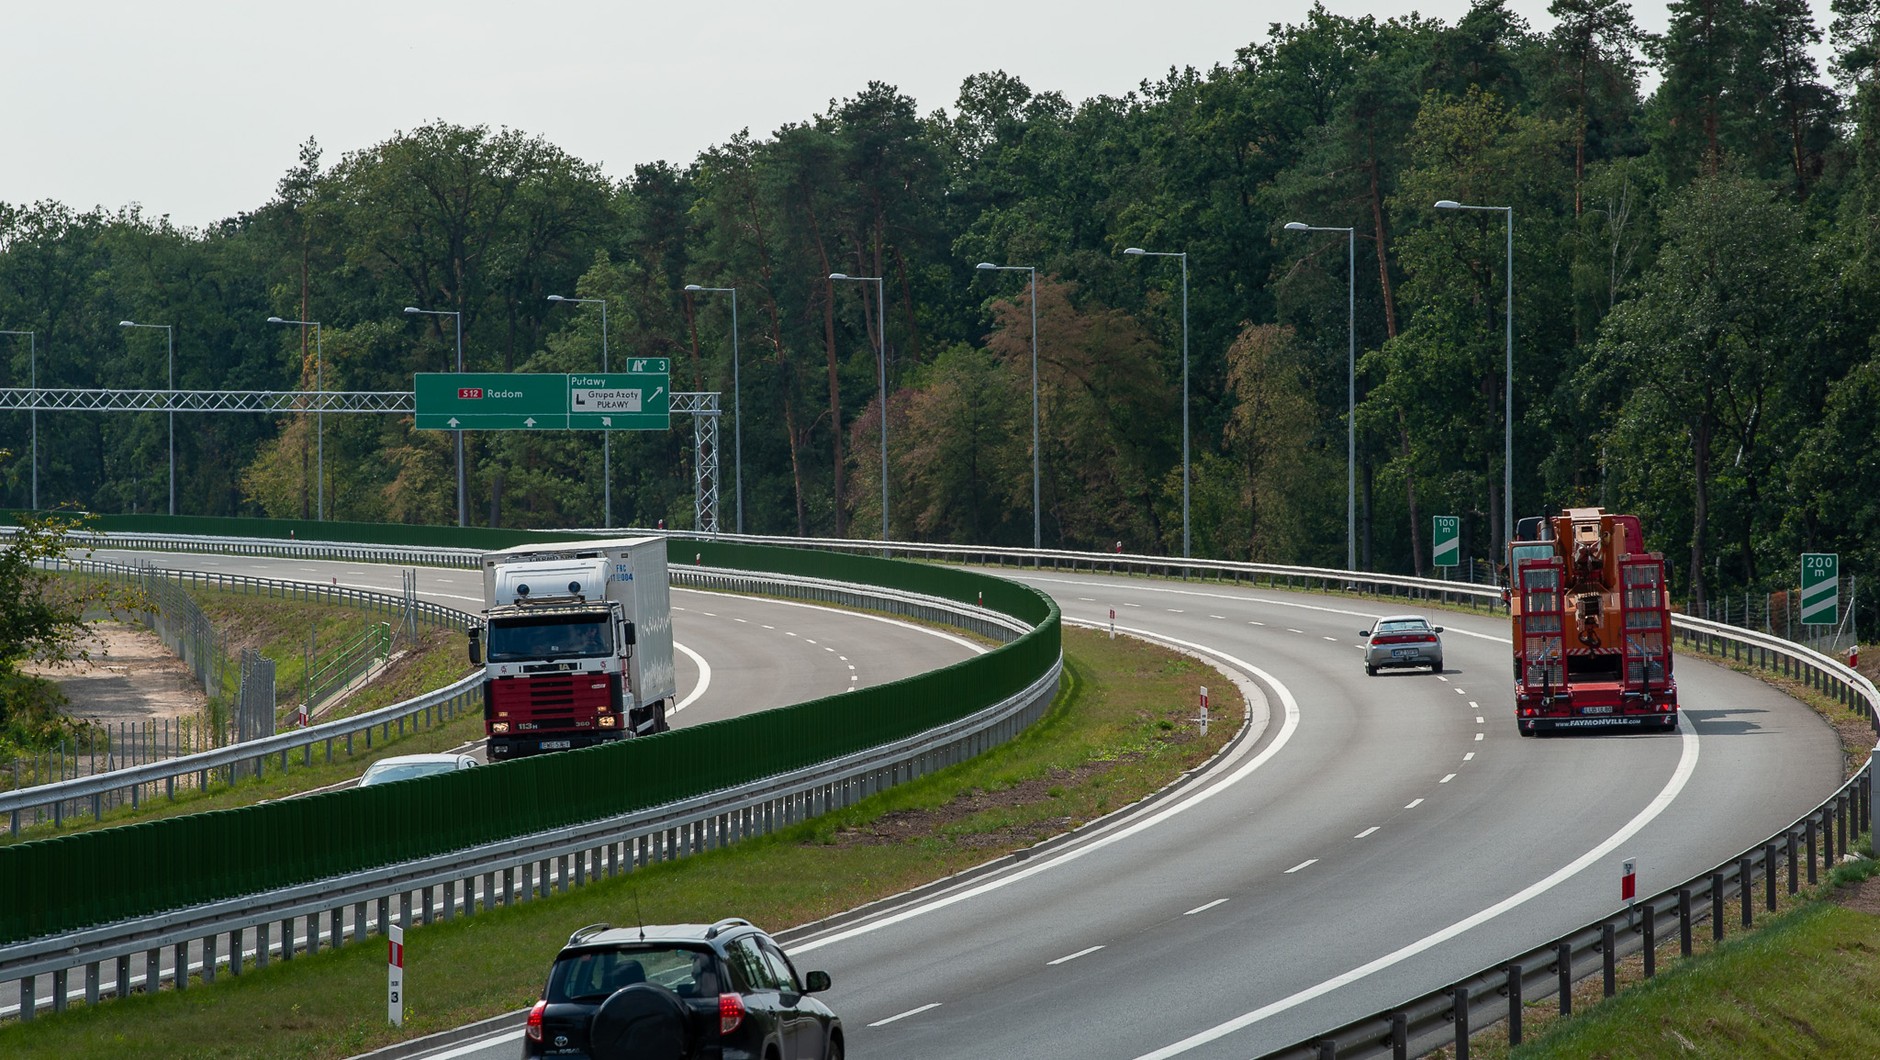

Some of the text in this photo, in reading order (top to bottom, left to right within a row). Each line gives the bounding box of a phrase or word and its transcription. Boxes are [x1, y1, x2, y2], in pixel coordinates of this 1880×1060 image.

[659, 361, 665, 371] 3
[571, 377, 606, 387] Puławy
[488, 389, 522, 398] Radom
[588, 391, 638, 399] Grupa Azoty
[1807, 557, 1833, 568] 200
[1814, 569, 1825, 577] m
[391, 991, 399, 1003] 3
